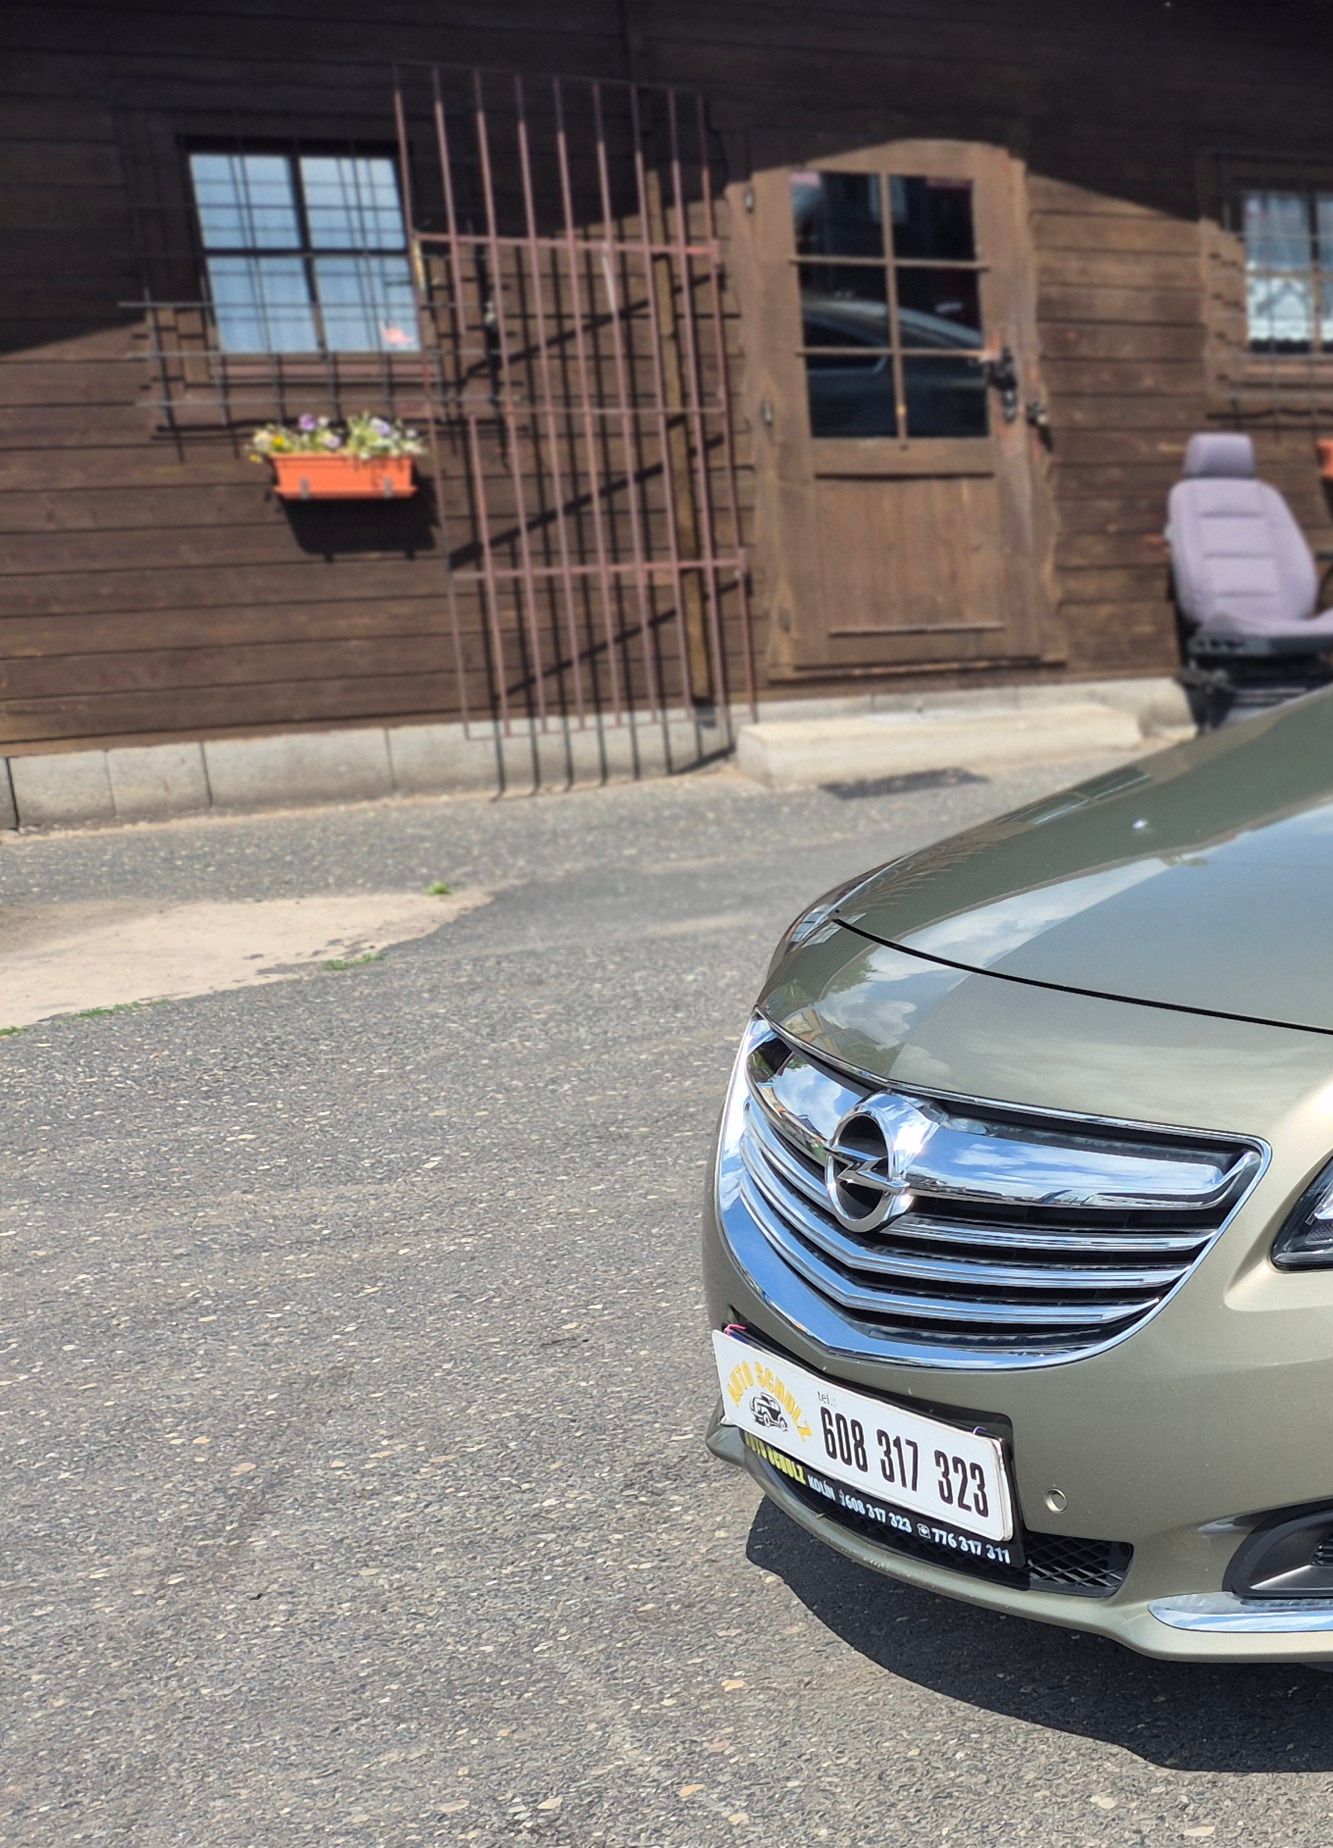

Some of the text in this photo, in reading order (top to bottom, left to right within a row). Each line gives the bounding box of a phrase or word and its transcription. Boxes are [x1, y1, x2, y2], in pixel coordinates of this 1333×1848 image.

[820, 1406, 989, 1518] 608 317 323
[845, 1494, 866, 1516] 608
[865, 1504, 887, 1524] 317
[888, 1513, 913, 1534] 323
[932, 1528, 958, 1549] 776
[958, 1536, 982, 1557] 317
[986, 1544, 1011, 1565] 311
